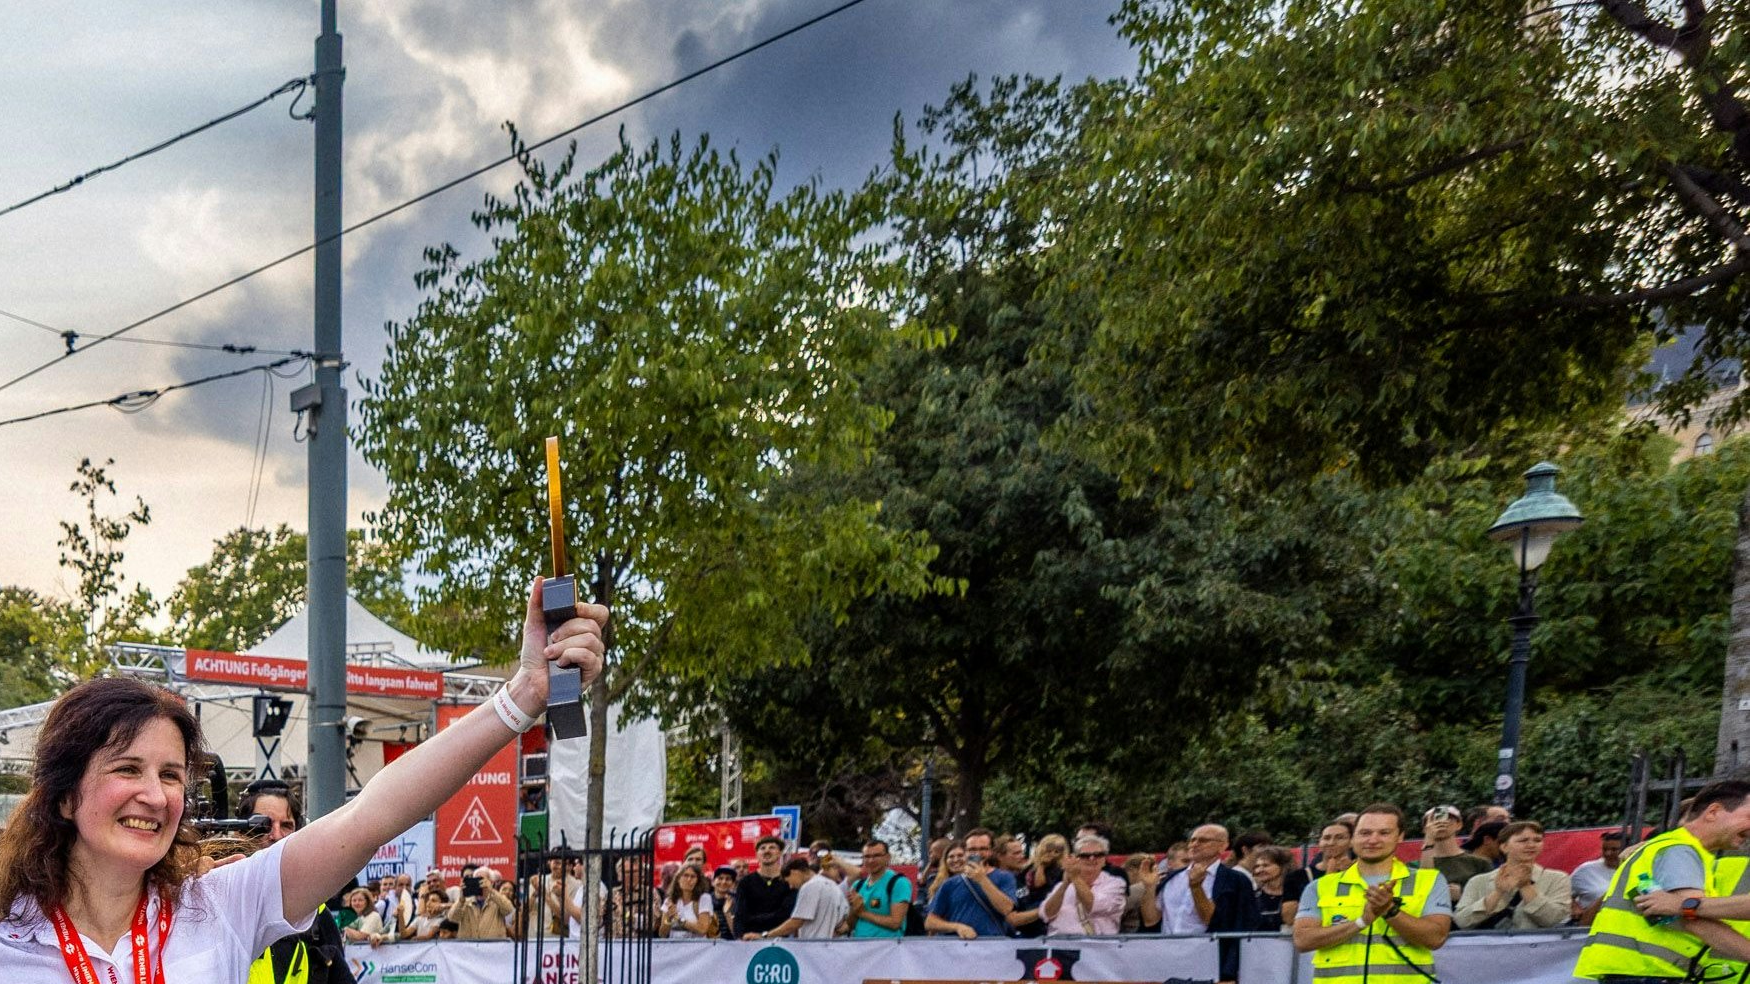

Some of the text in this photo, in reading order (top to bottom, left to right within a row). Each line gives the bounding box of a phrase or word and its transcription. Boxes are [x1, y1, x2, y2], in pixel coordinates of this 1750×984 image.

[194, 657, 438, 691] ACHTUNG Fußgänger itte langsam fahren!
[467, 772, 511, 785] TUNG!
[442, 855, 509, 867] Bitte langsam
[367, 863, 403, 880] WORLD
[137, 948, 148, 977] WIENER
[380, 961, 438, 974] HanseCom
[754, 963, 791, 984] GIRO
